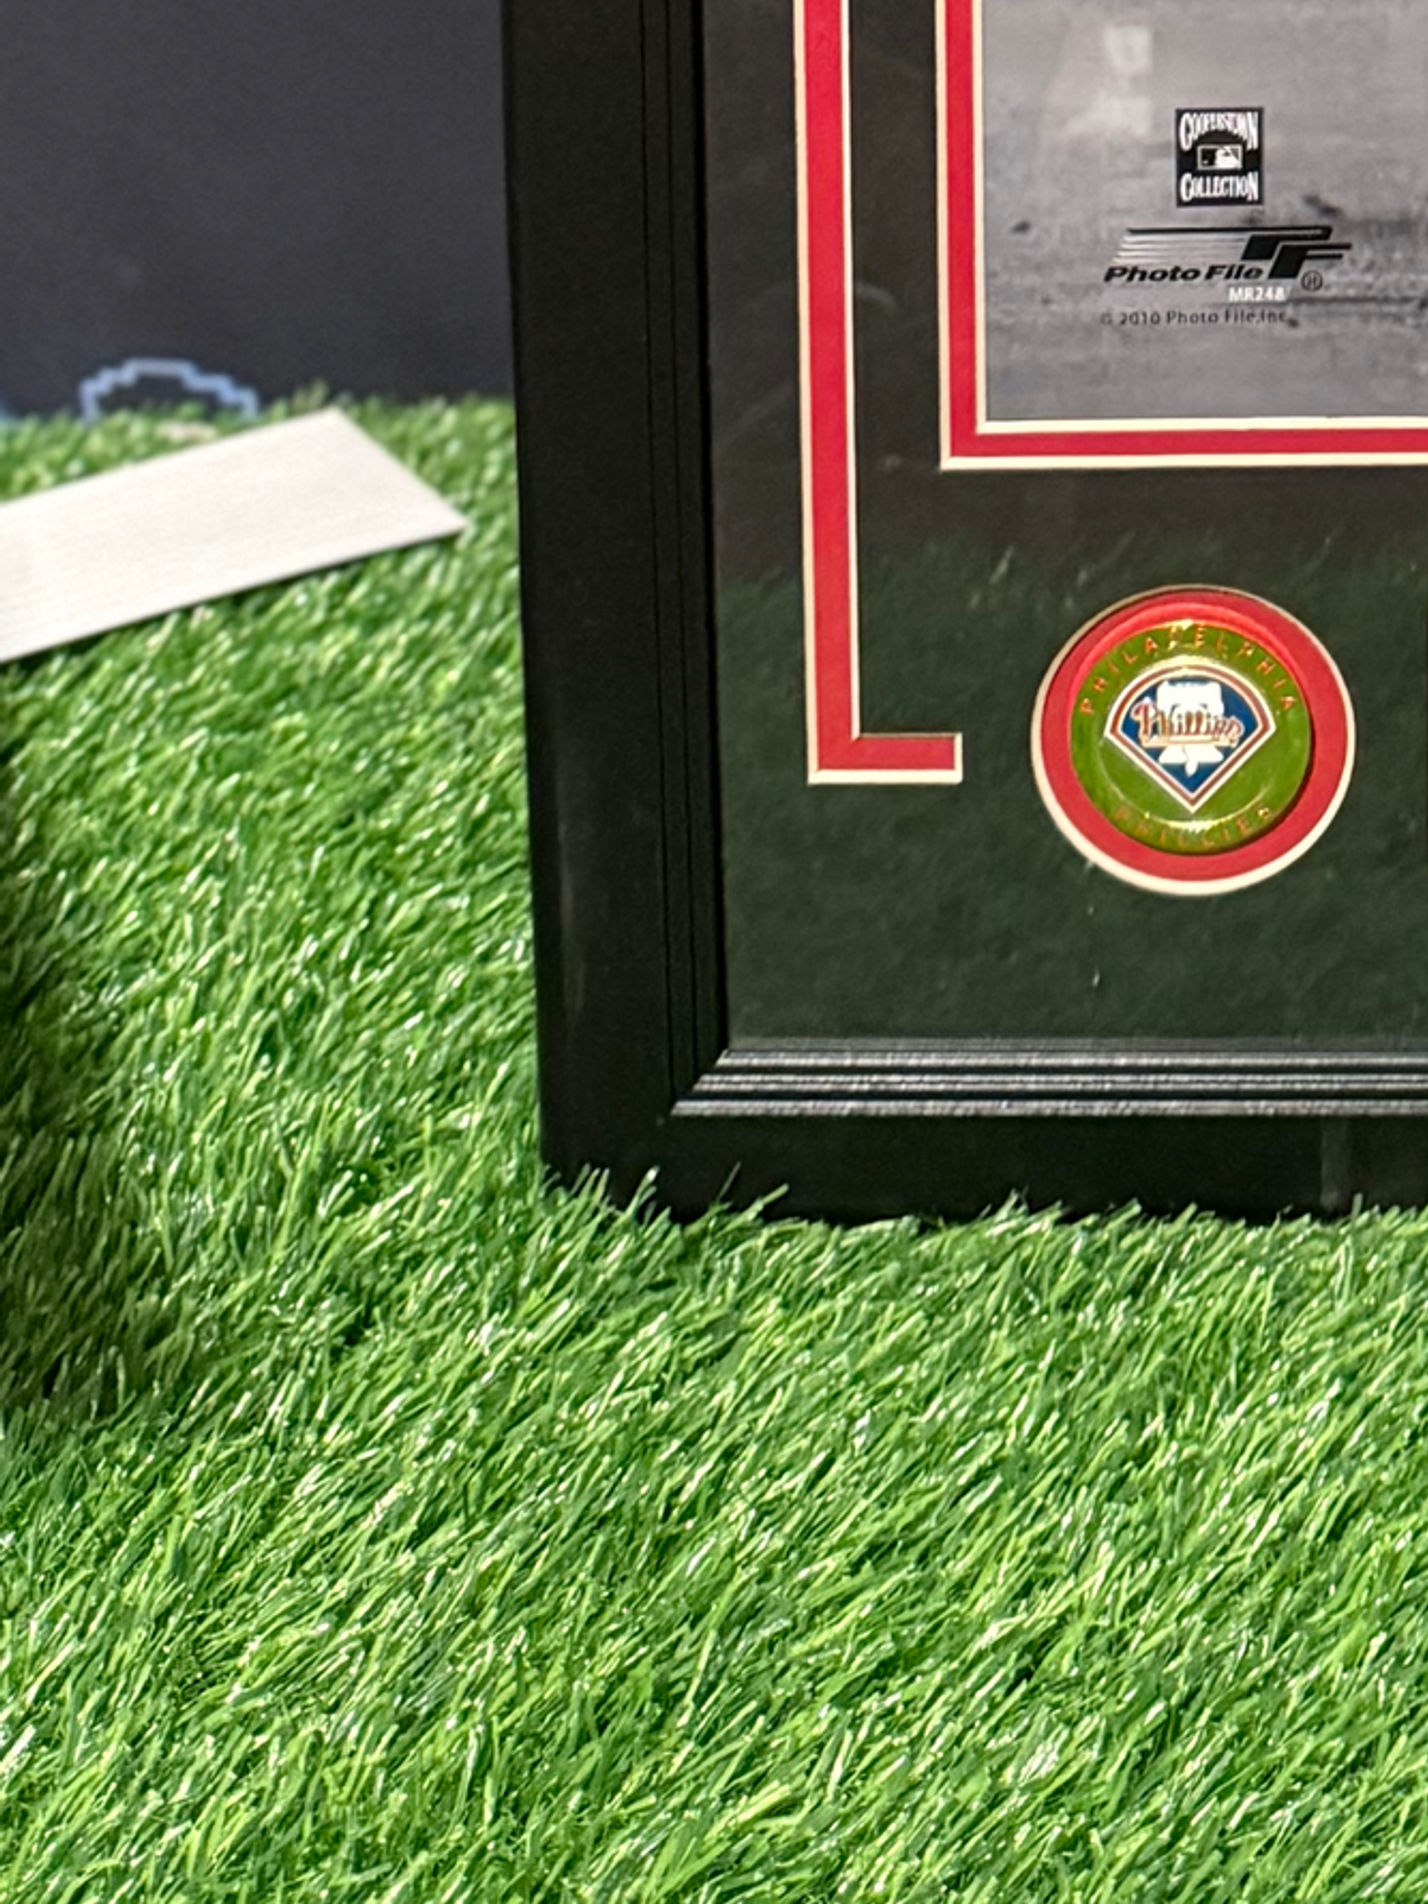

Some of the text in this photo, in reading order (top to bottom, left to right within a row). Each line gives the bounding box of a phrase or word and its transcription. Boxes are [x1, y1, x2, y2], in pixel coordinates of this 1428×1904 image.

[1180, 171, 1259, 203] COLLECTION
[1103, 264, 1264, 283] Photo File
[1119, 311, 1161, 327] 2010
[1166, 309, 1219, 325] Photo
[1130, 698, 1244, 747] Phillies
